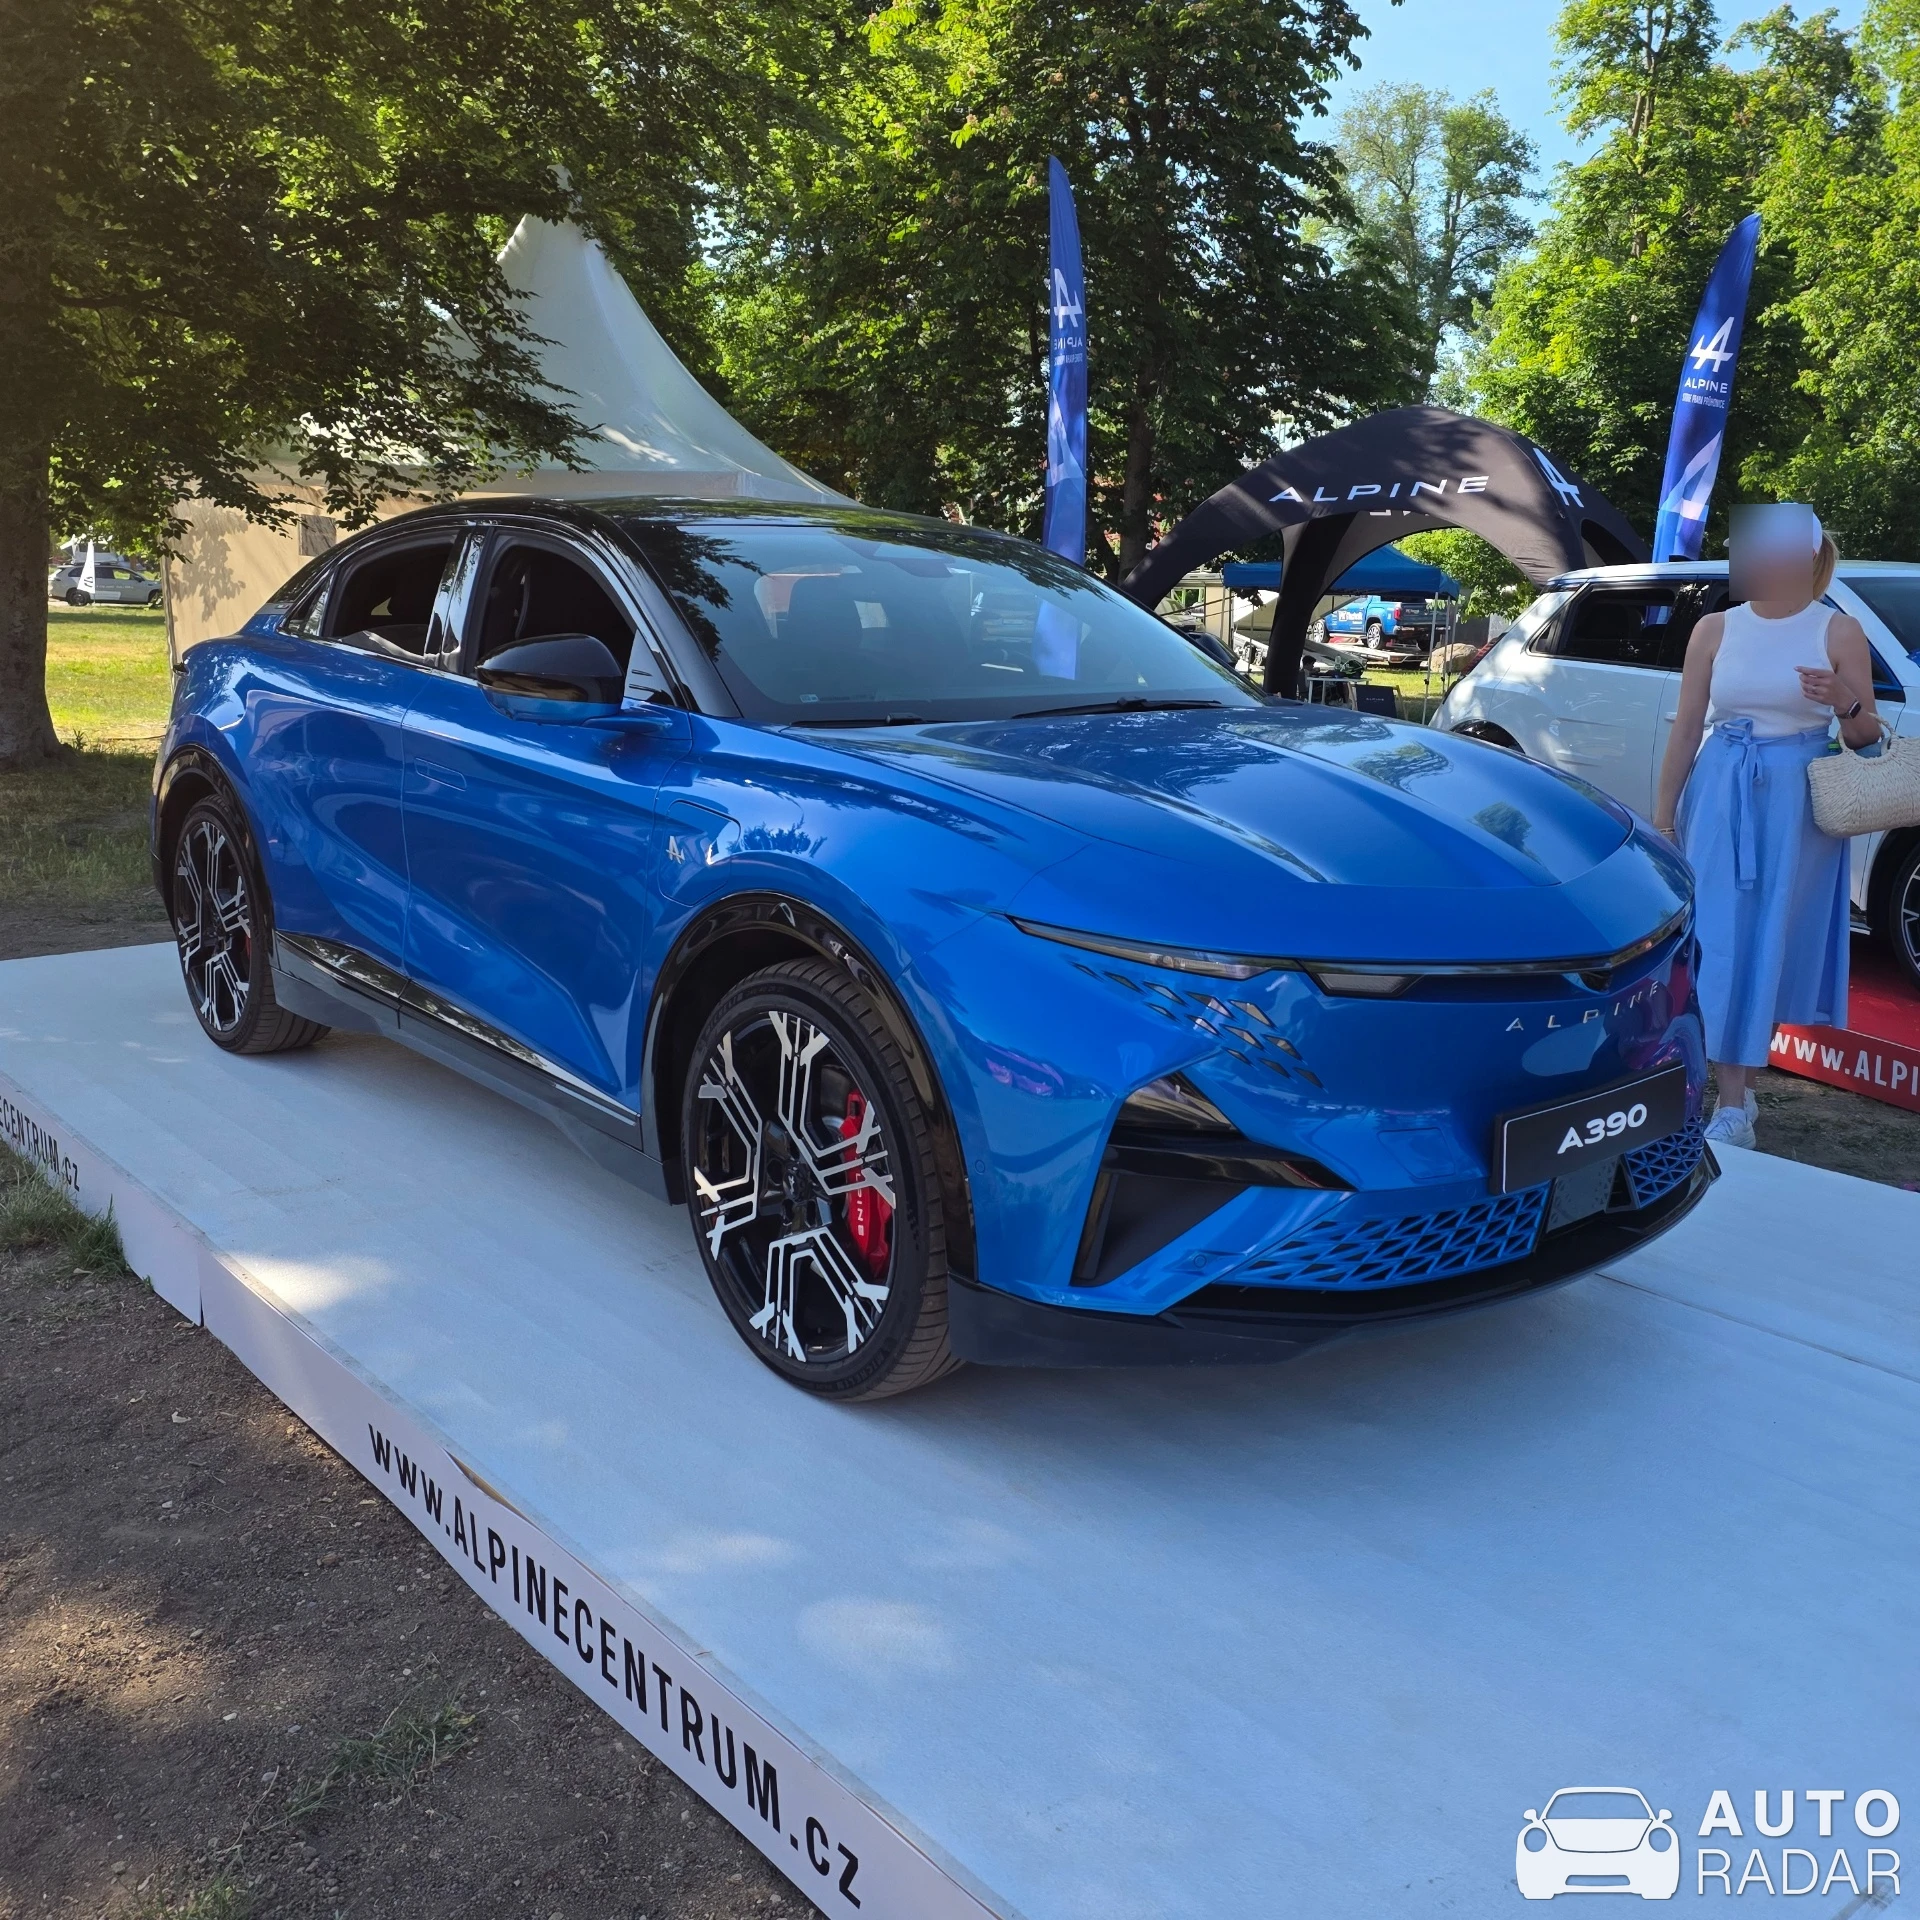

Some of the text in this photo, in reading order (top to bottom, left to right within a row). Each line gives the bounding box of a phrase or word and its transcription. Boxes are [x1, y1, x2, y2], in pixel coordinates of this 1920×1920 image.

[1684, 377, 1728, 394] ALPINE
[1269, 475, 1490, 502] ALPINE
[1505, 980, 1659, 1032] ALPINE
[0, 1095, 80, 1193] CENTRUMCZ
[1557, 1104, 1648, 1155] A390
[855, 1157, 866, 1237] LPINE
[368, 1423, 862, 1910] WWW.ALPINECENTRUM.CZ
